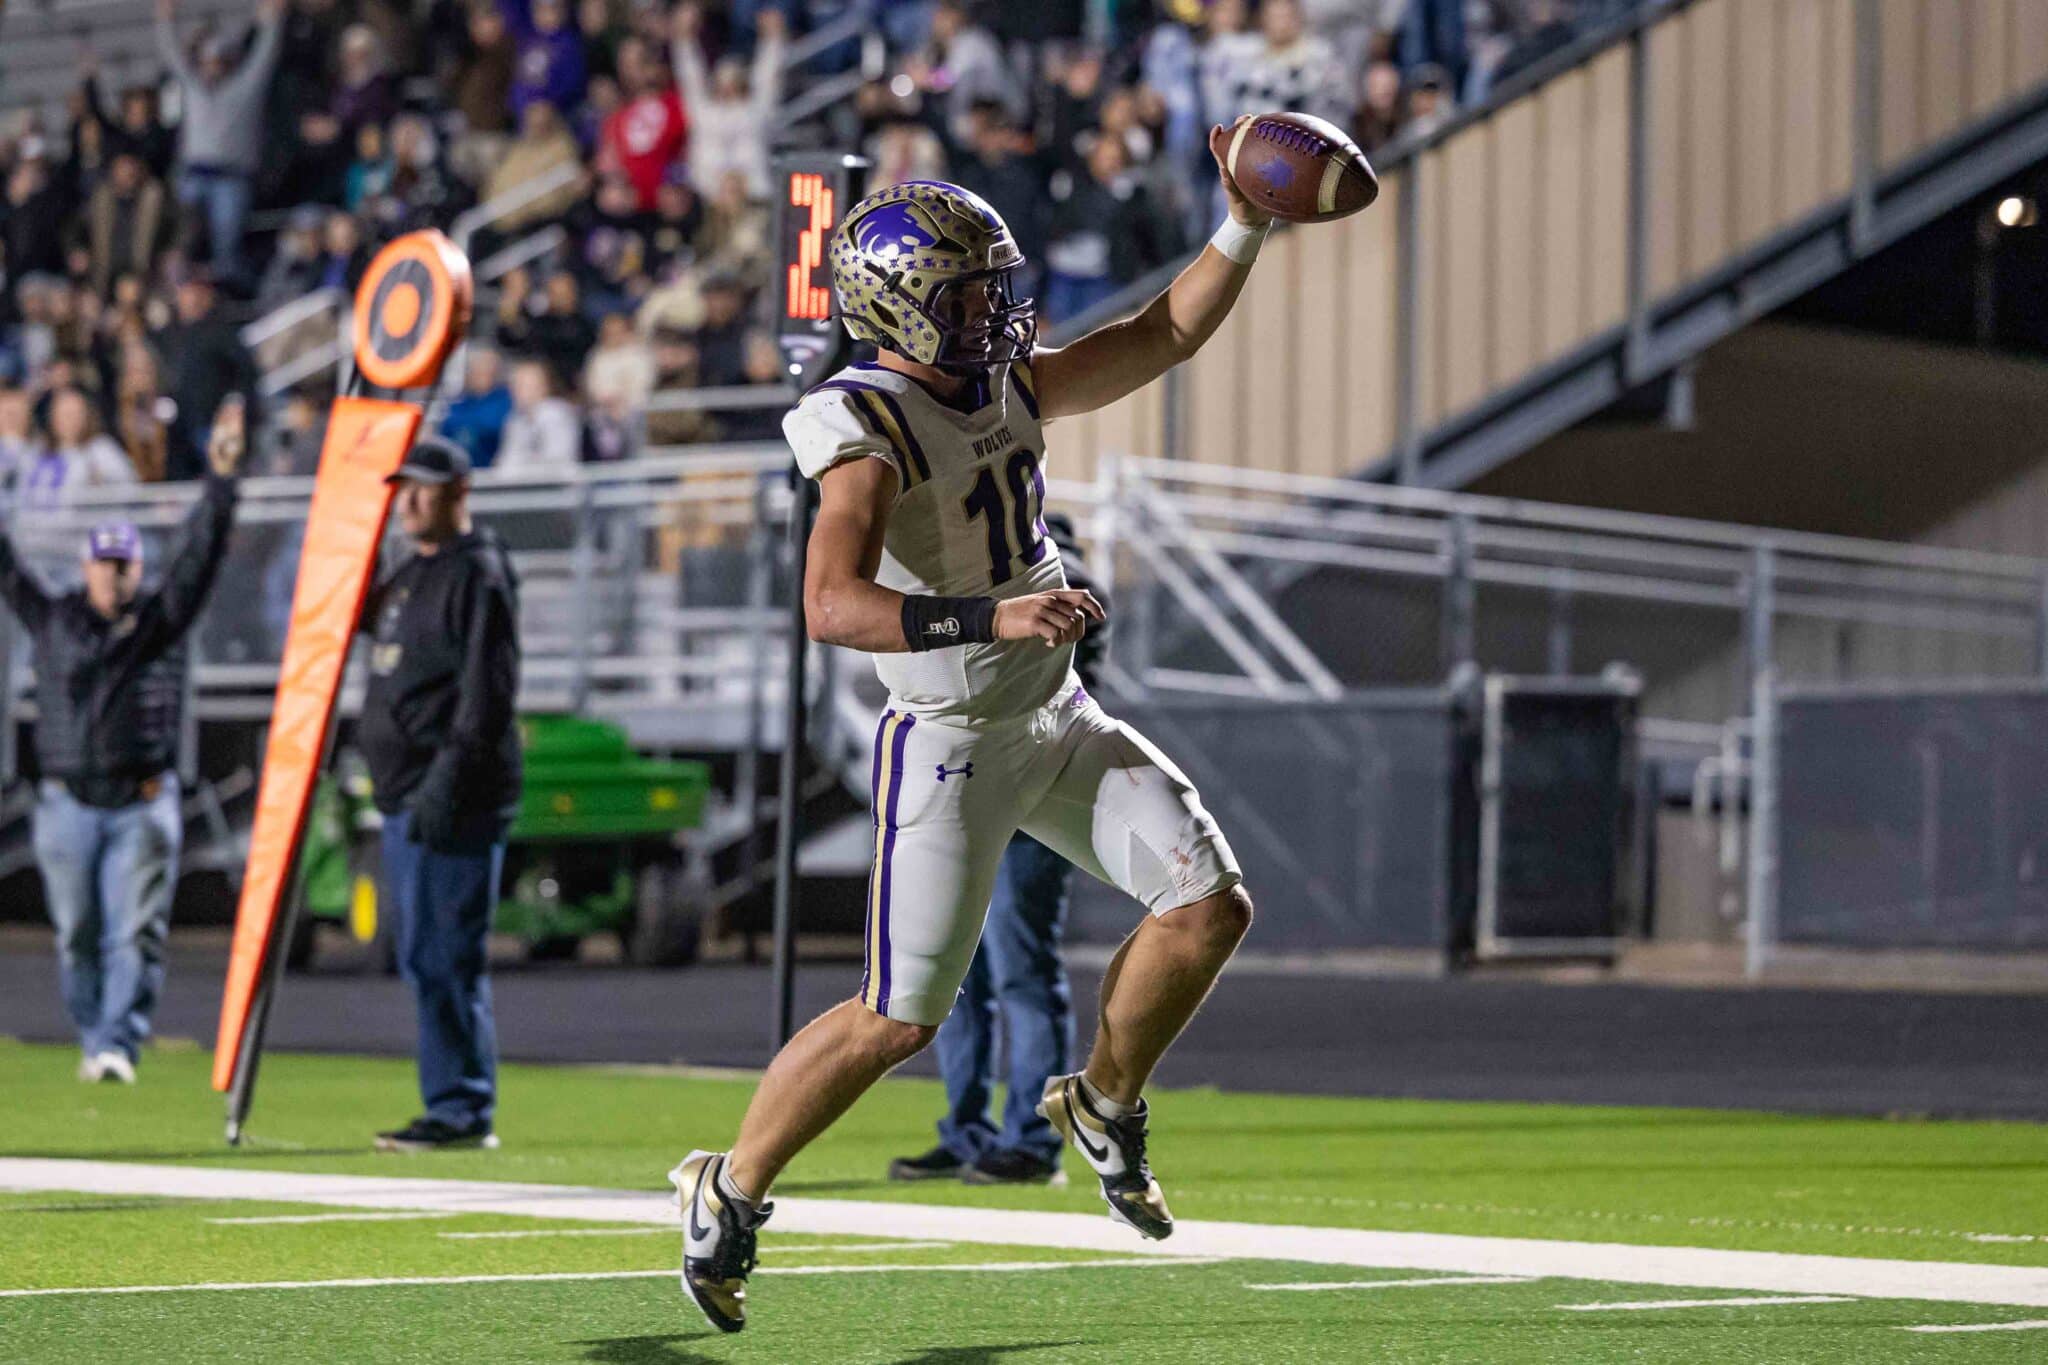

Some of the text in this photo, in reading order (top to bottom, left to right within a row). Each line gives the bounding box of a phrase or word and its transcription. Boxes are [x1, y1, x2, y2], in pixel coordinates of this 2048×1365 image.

[788, 173, 833, 319] 2
[972, 425, 1013, 459] WOLVES
[962, 447, 1050, 586] 10
